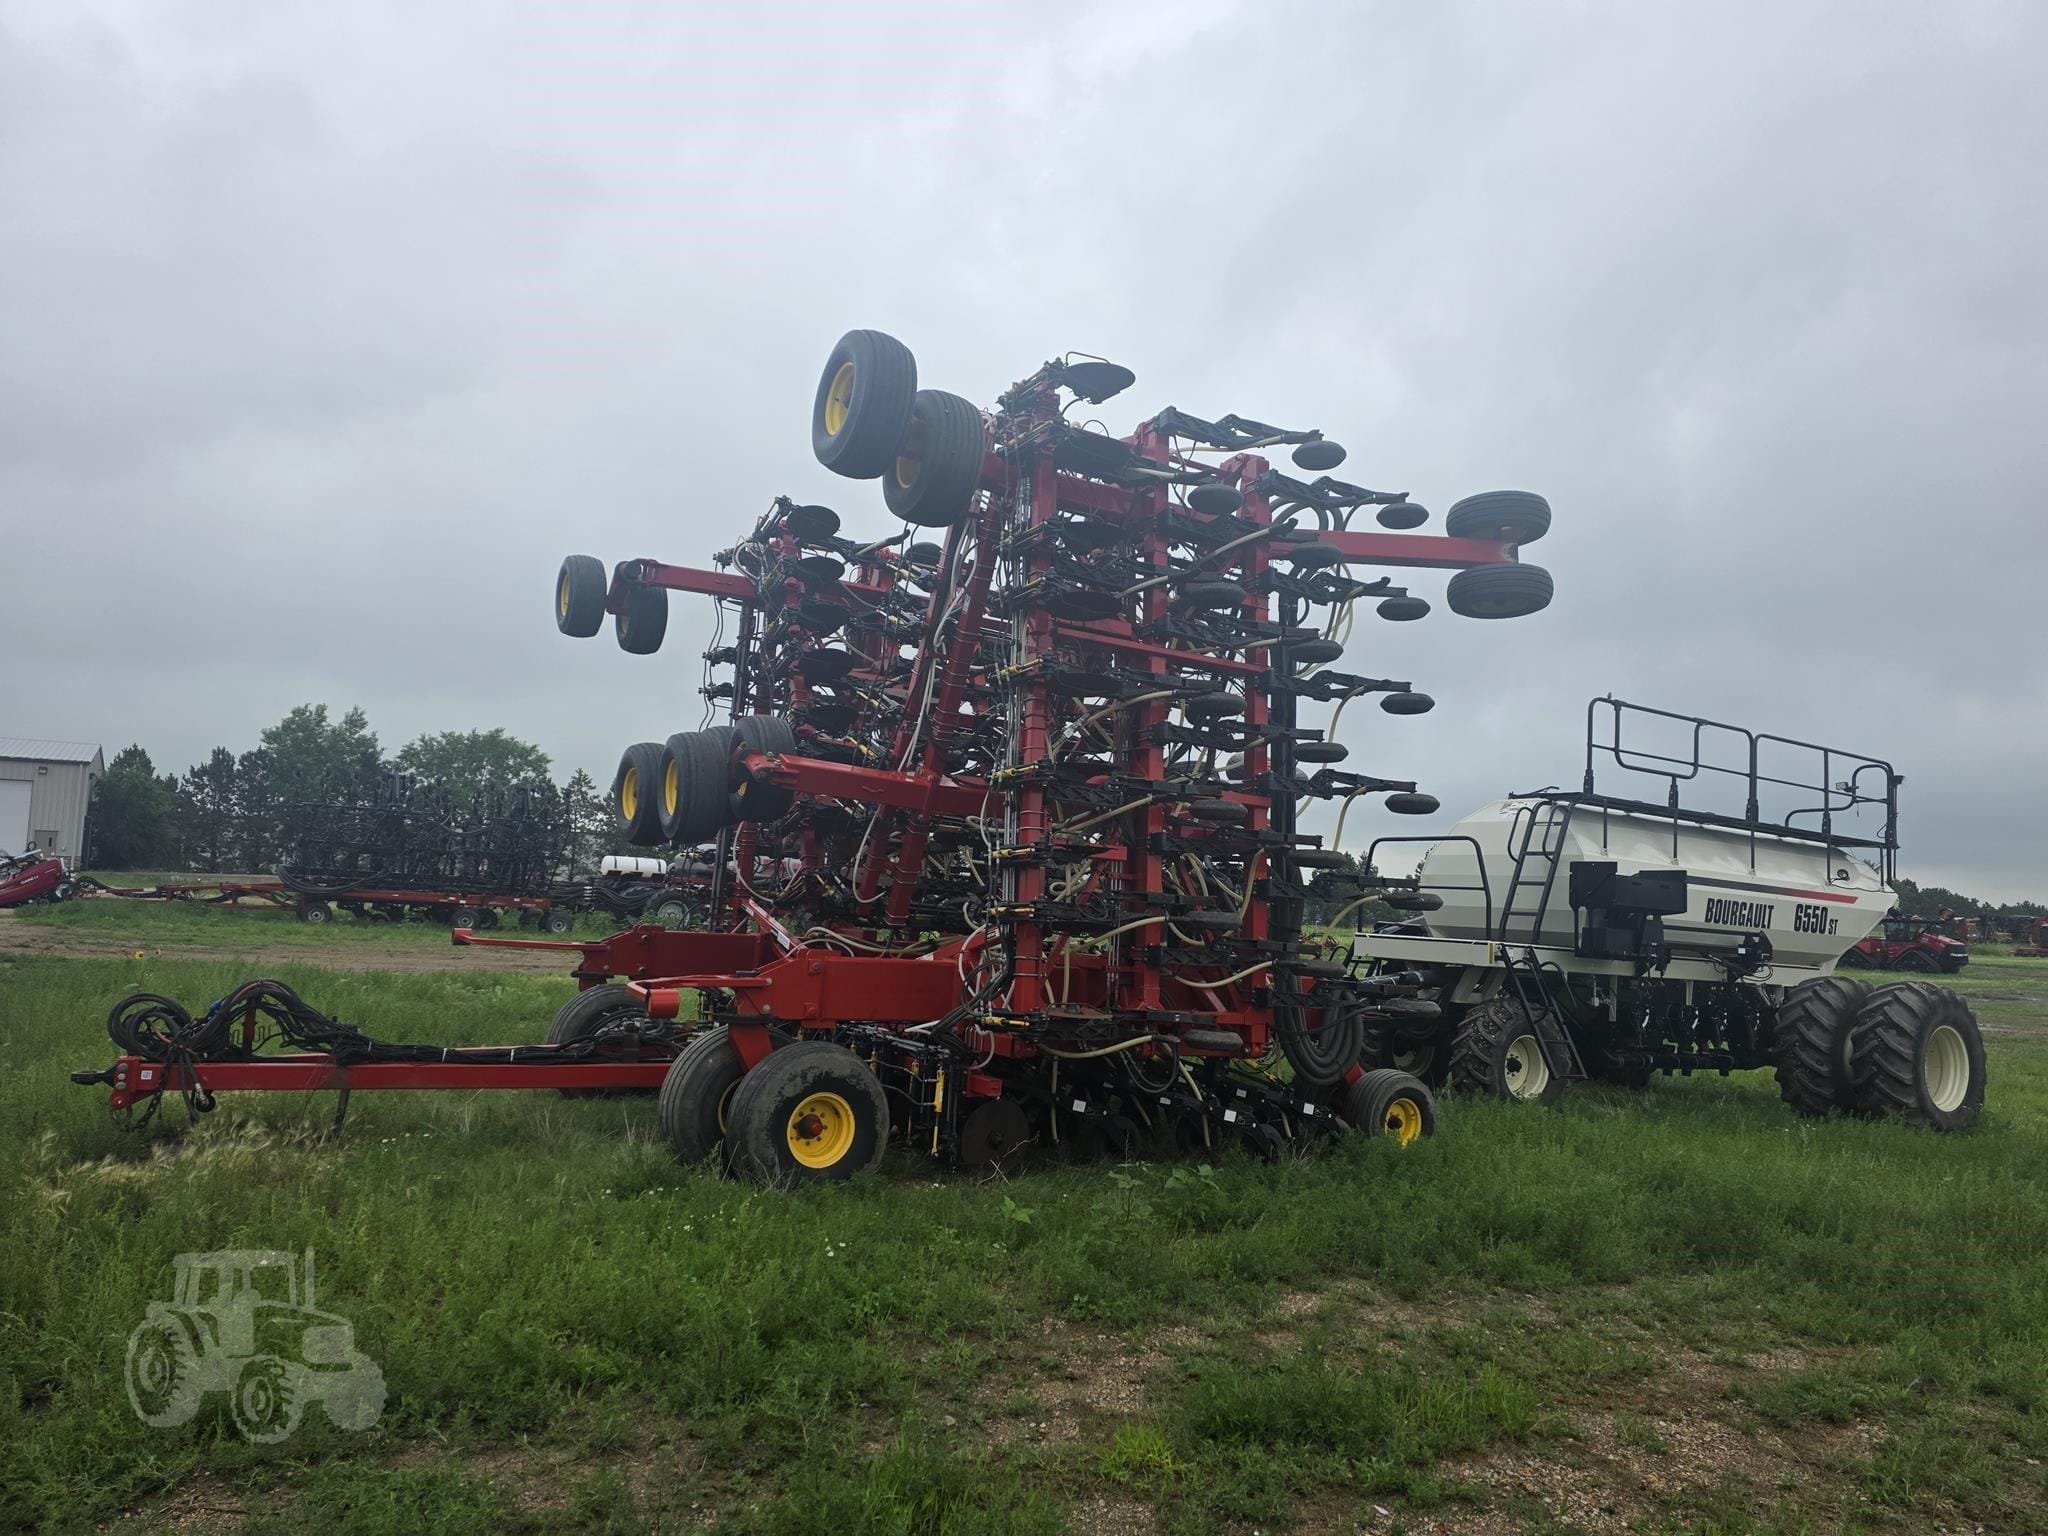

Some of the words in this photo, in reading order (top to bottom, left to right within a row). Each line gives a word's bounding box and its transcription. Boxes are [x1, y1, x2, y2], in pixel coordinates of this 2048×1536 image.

[1705, 898, 1774, 929] BOURGAULT
[1794, 903, 1828, 934] 6550
[1828, 918, 1838, 935] ST
